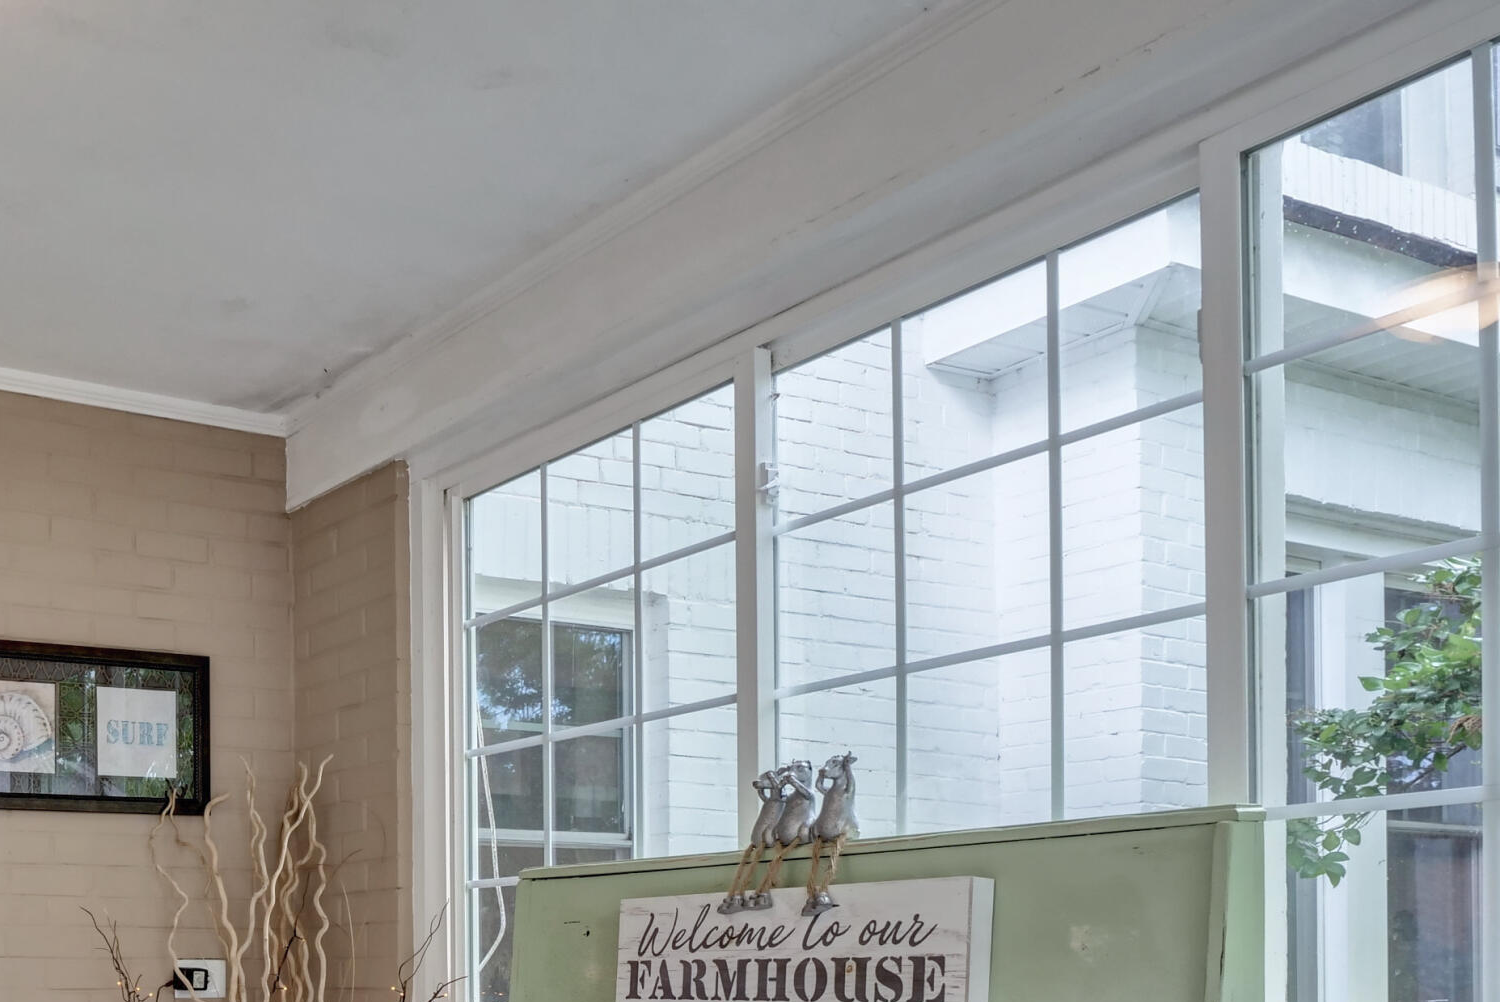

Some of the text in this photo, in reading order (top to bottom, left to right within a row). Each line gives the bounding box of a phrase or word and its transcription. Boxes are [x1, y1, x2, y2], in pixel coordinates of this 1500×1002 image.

[106, 719, 169, 746] SURF
[637, 903, 939, 957] Welcome to our
